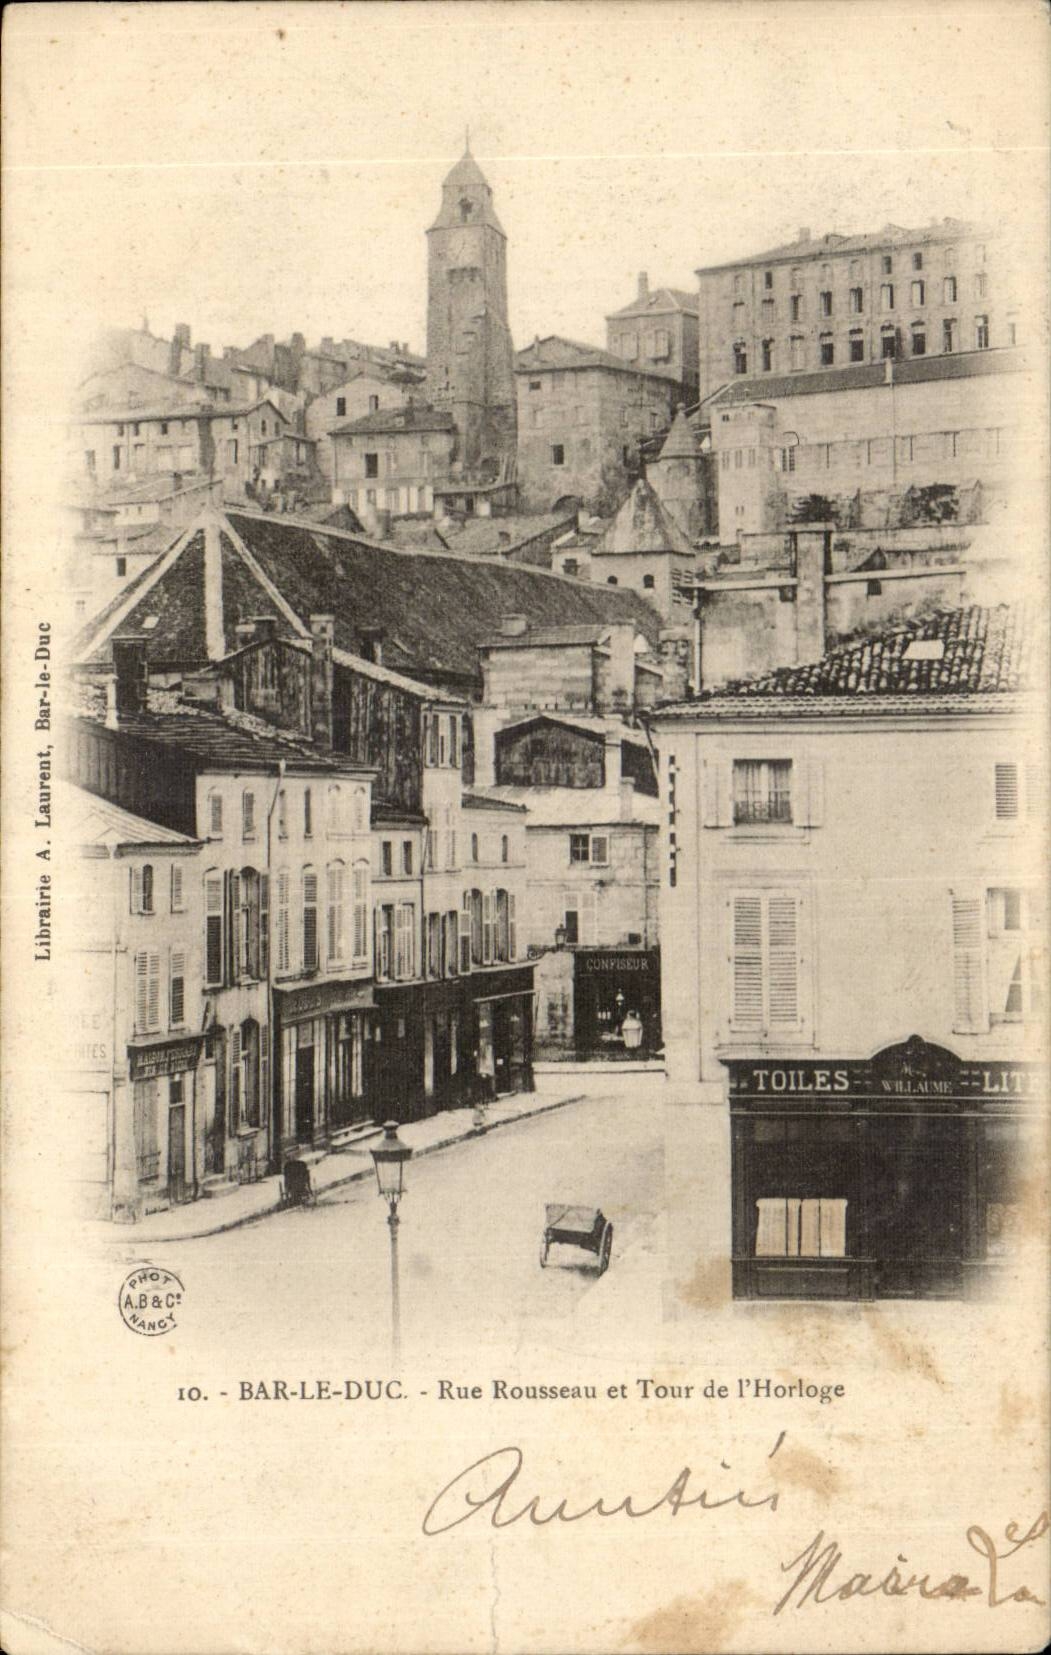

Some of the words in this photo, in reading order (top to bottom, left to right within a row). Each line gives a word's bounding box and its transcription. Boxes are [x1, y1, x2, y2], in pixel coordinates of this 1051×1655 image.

[586, 958, 649, 971] CONFISEUR
[753, 1070, 850, 1091] TOILES
[881, 1079, 953, 1094] WILLAUME
